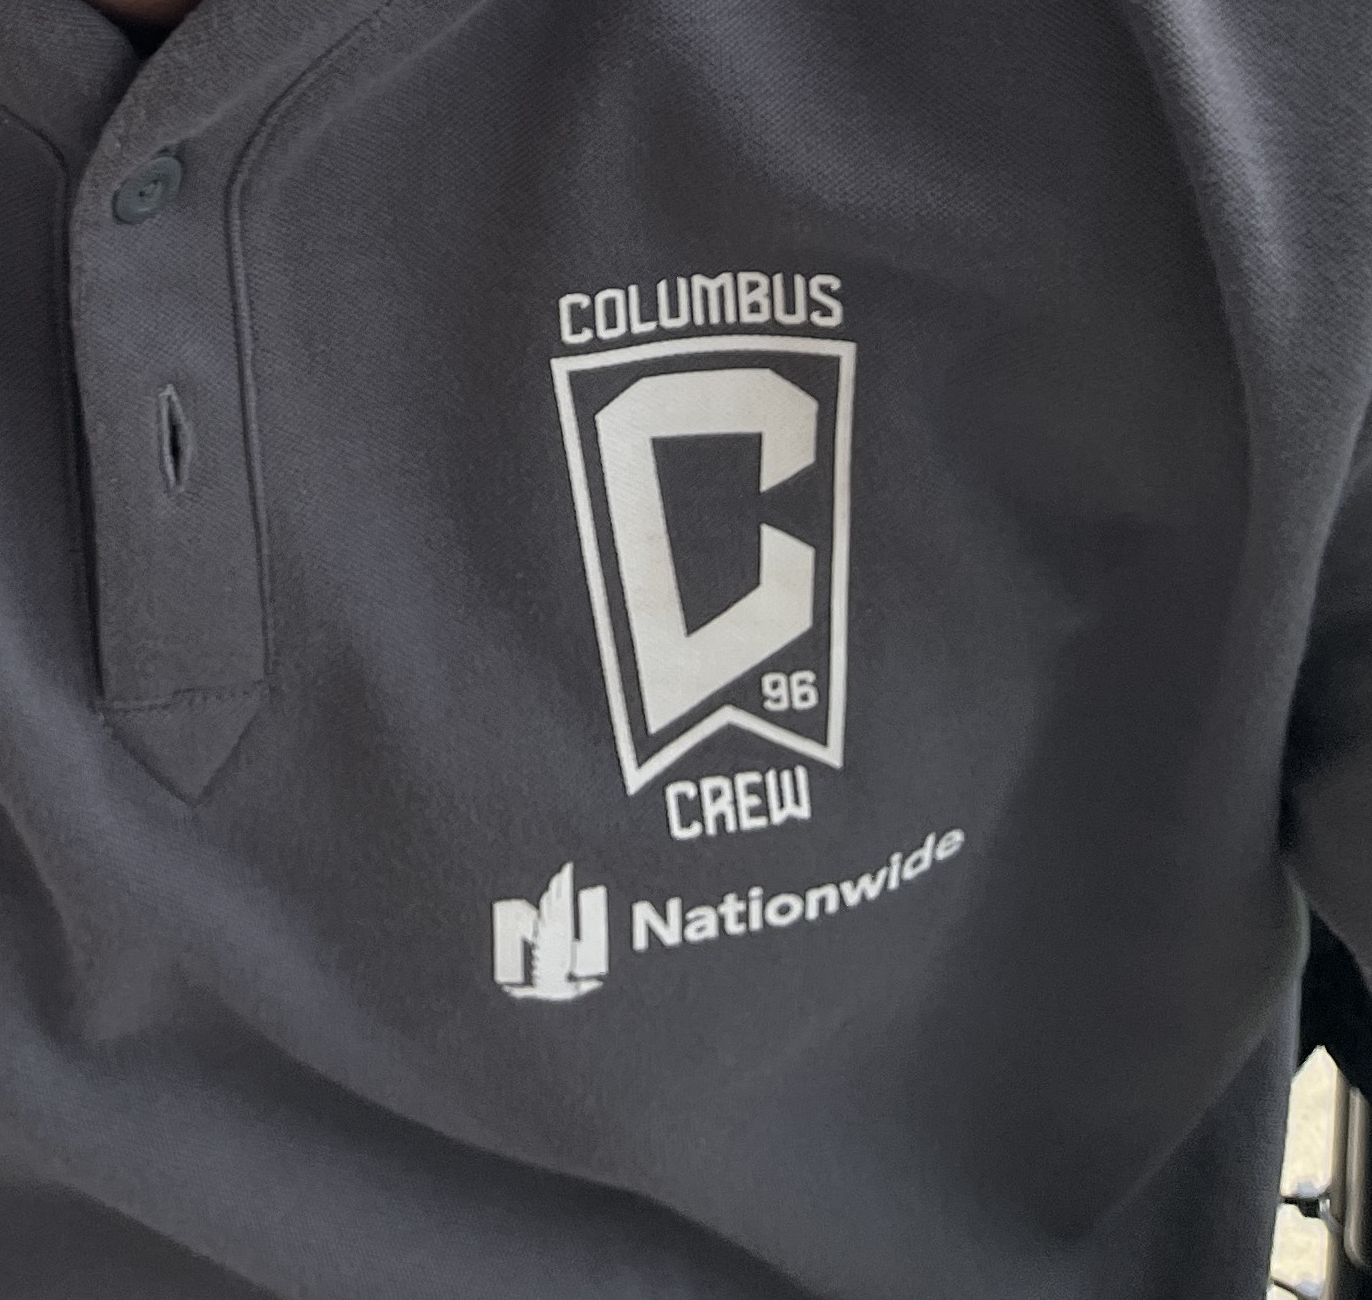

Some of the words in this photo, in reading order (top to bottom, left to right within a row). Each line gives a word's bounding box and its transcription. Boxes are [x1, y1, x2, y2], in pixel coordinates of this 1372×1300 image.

[558, 270, 845, 344] COLUMBUS
[760, 669, 820, 712] 96
[664, 764, 812, 841] CREW
[631, 828, 966, 952] Nationwide
